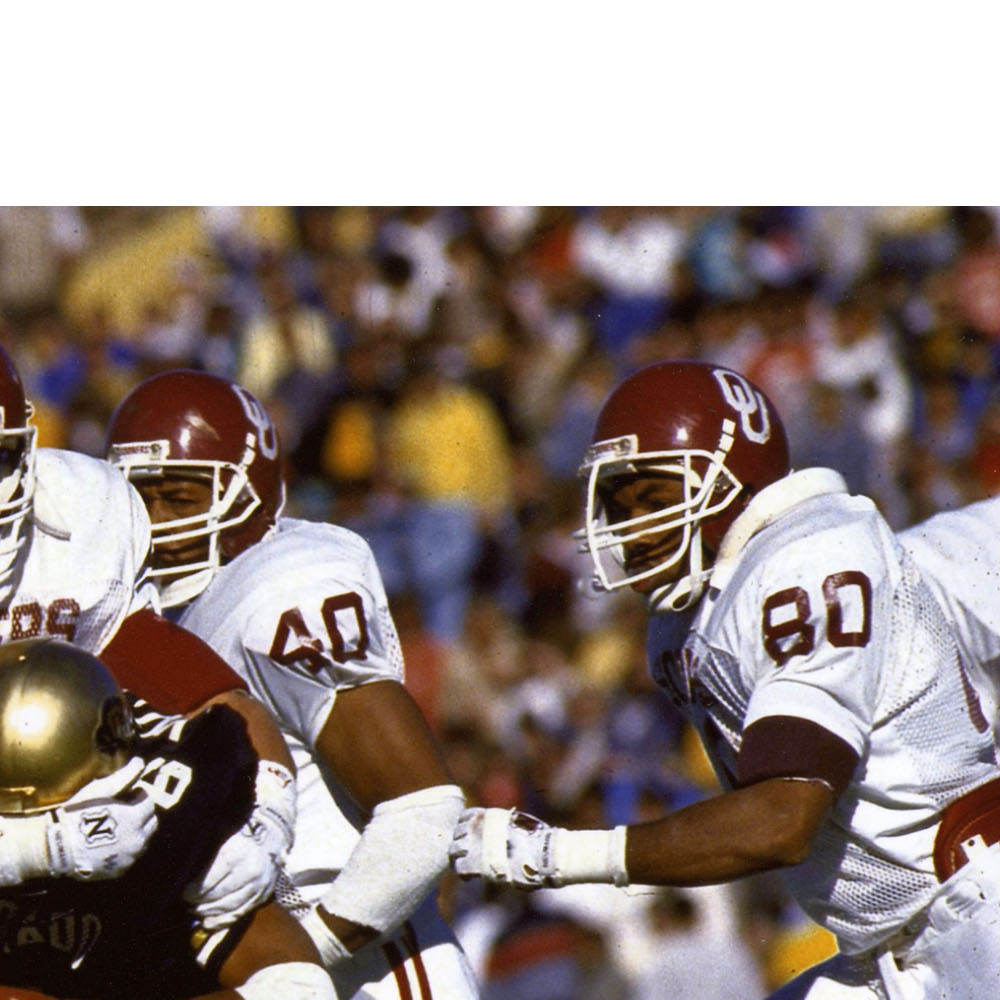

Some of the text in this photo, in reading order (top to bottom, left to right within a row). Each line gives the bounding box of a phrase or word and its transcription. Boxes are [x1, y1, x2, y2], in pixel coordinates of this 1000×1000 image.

[712, 369, 770, 444] OU
[269, 591, 370, 676] 40
[762, 570, 873, 667] 80
